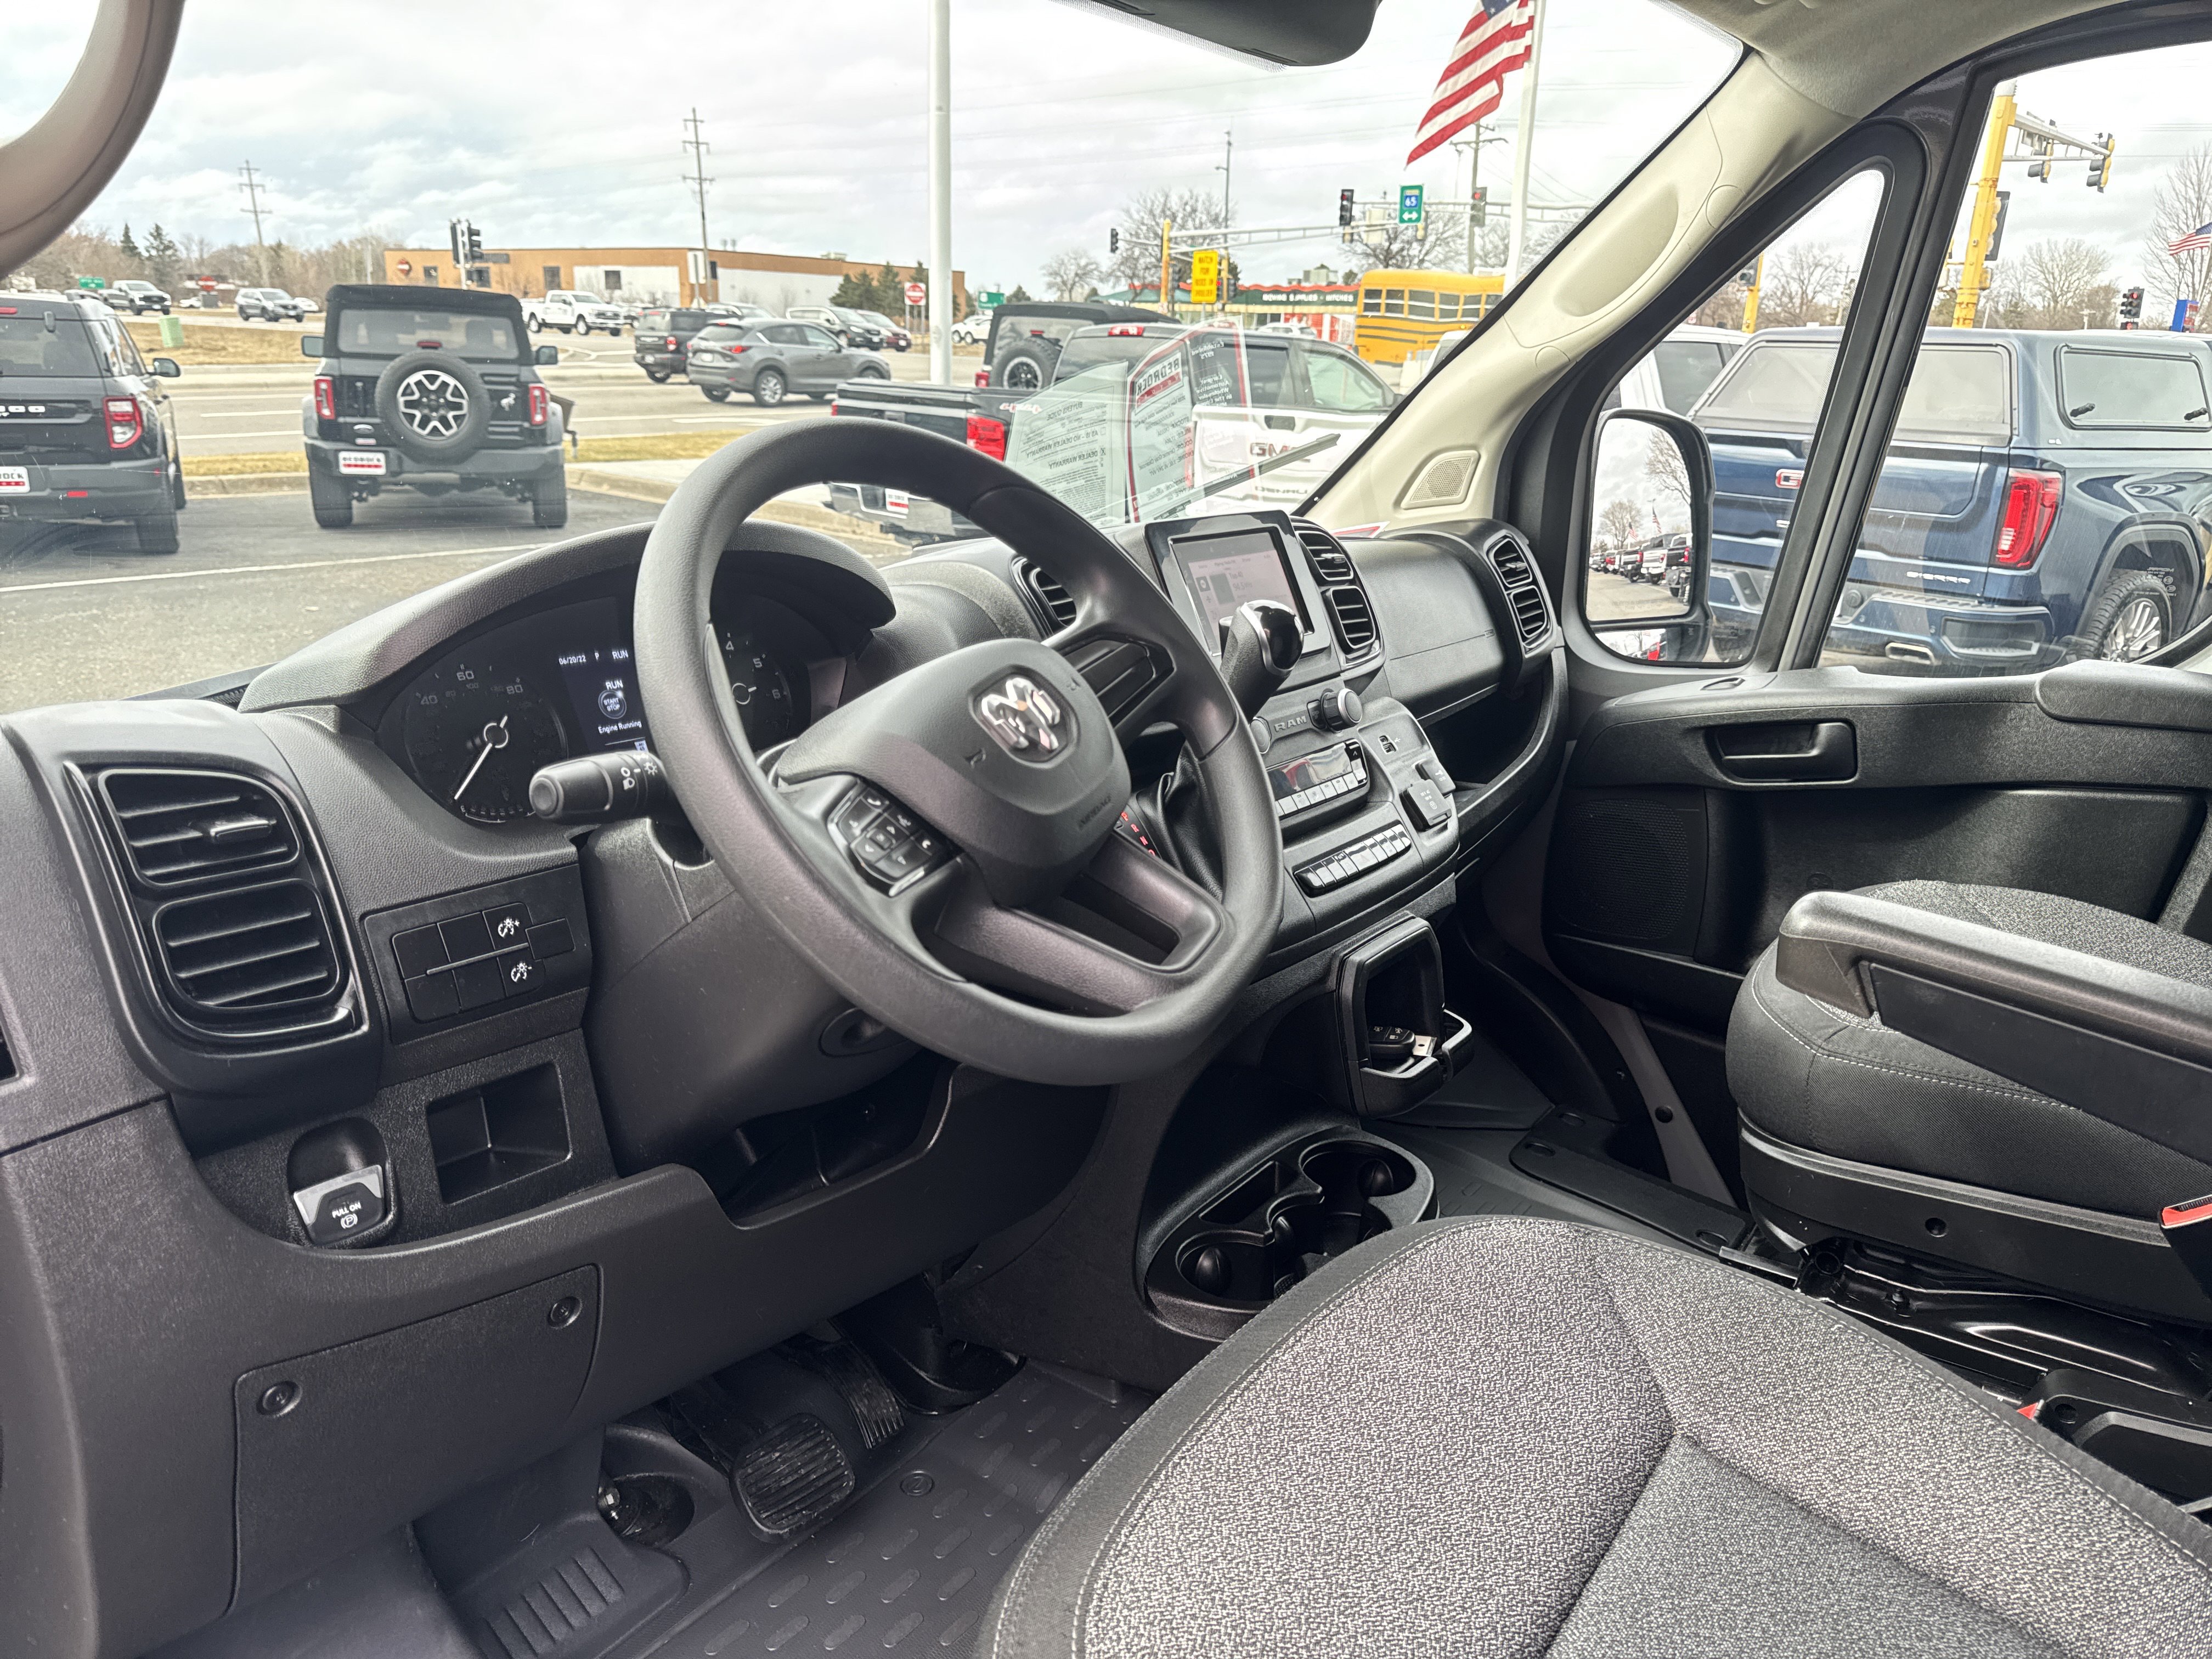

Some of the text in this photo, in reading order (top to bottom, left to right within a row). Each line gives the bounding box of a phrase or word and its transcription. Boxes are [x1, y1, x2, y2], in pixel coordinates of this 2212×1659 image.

[1405, 196, 1417, 207] 65
[1906, 571, 1971, 584] SIERRA
[558, 651, 629, 665] 06/20/22 P RUN
[753, 658, 763, 669] 5
[456, 670, 475, 681] 60
[506, 684, 523, 695] 80
[605, 680, 624, 690] RUN
[420, 695, 438, 705] 40
[598, 720, 642, 734] Engine Running
[1273, 715, 1308, 732] RAM
[331, 1202, 362, 1218] PULL ON
